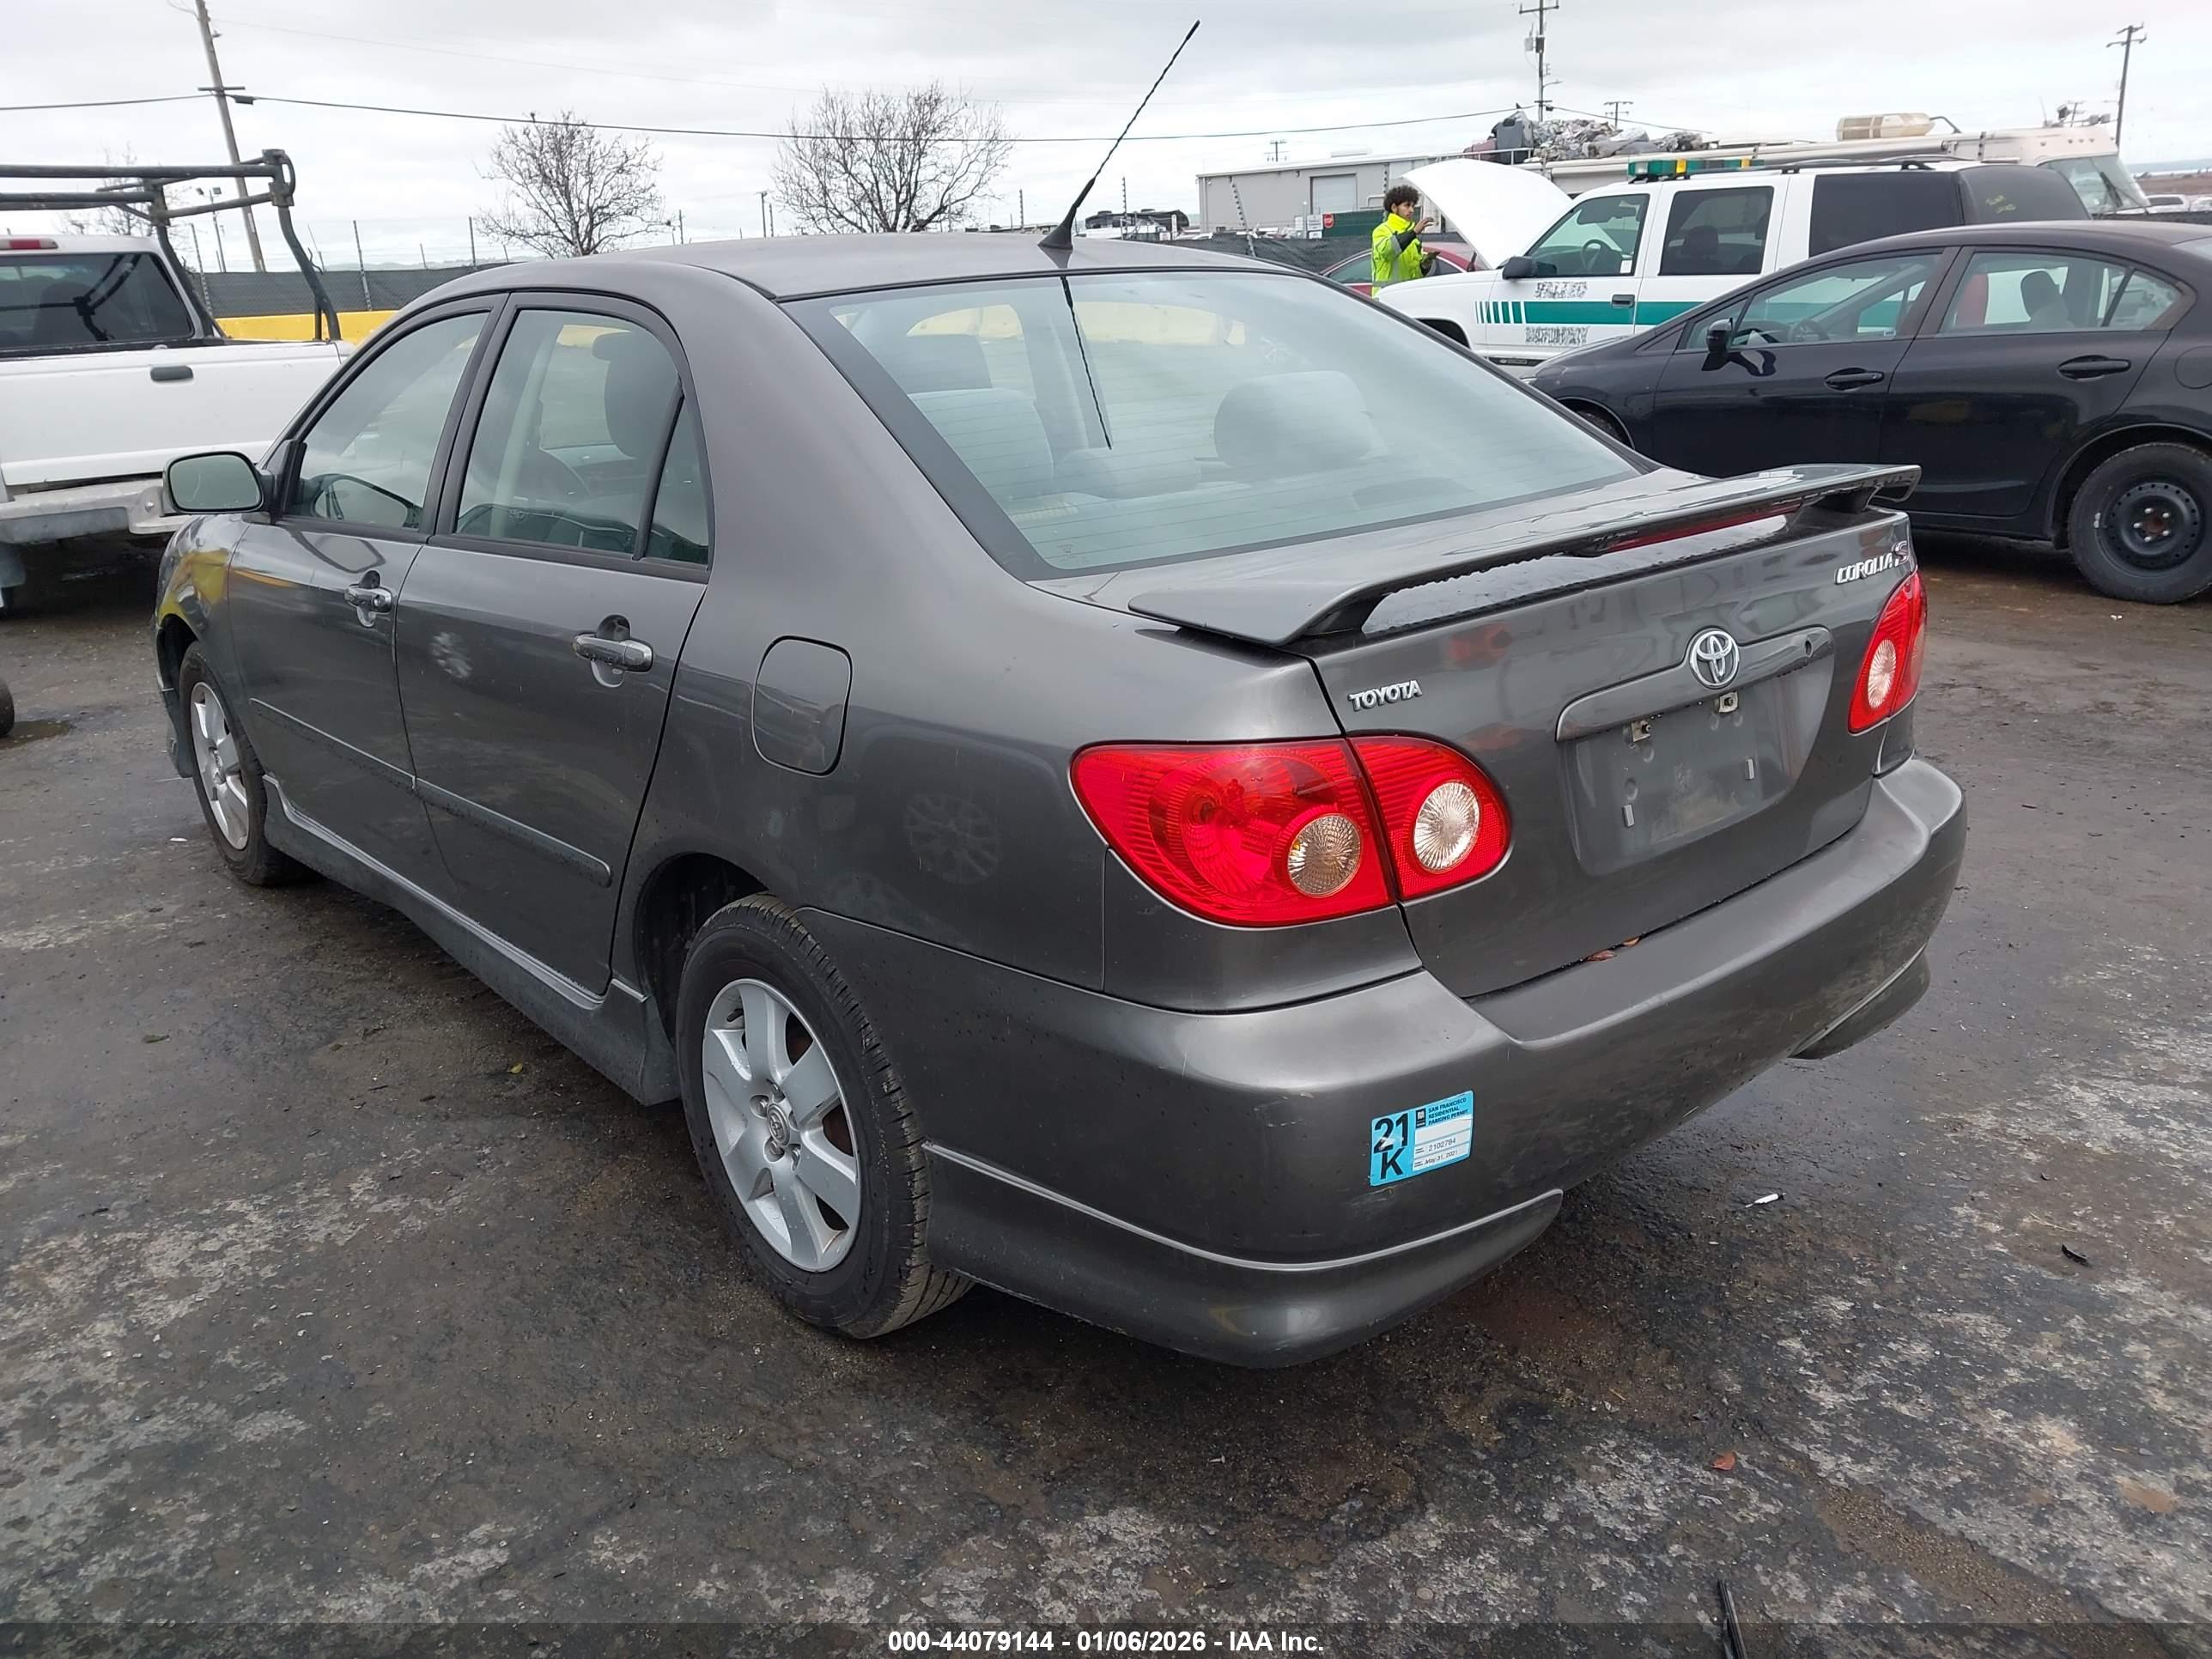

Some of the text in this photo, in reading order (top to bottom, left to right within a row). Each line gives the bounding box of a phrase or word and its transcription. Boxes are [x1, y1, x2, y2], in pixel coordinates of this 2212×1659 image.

[1835, 552, 1893, 584] COROLLA
[1347, 680, 1422, 711] TOYOTA
[1428, 1106, 1460, 1119] RESIDENTIAL
[1440, 1097, 1467, 1110] FRANCISCO
[1374, 1113, 1407, 1153] 21
[1428, 1115, 1450, 1125] PARKING
[1381, 1147, 1405, 1180] K
